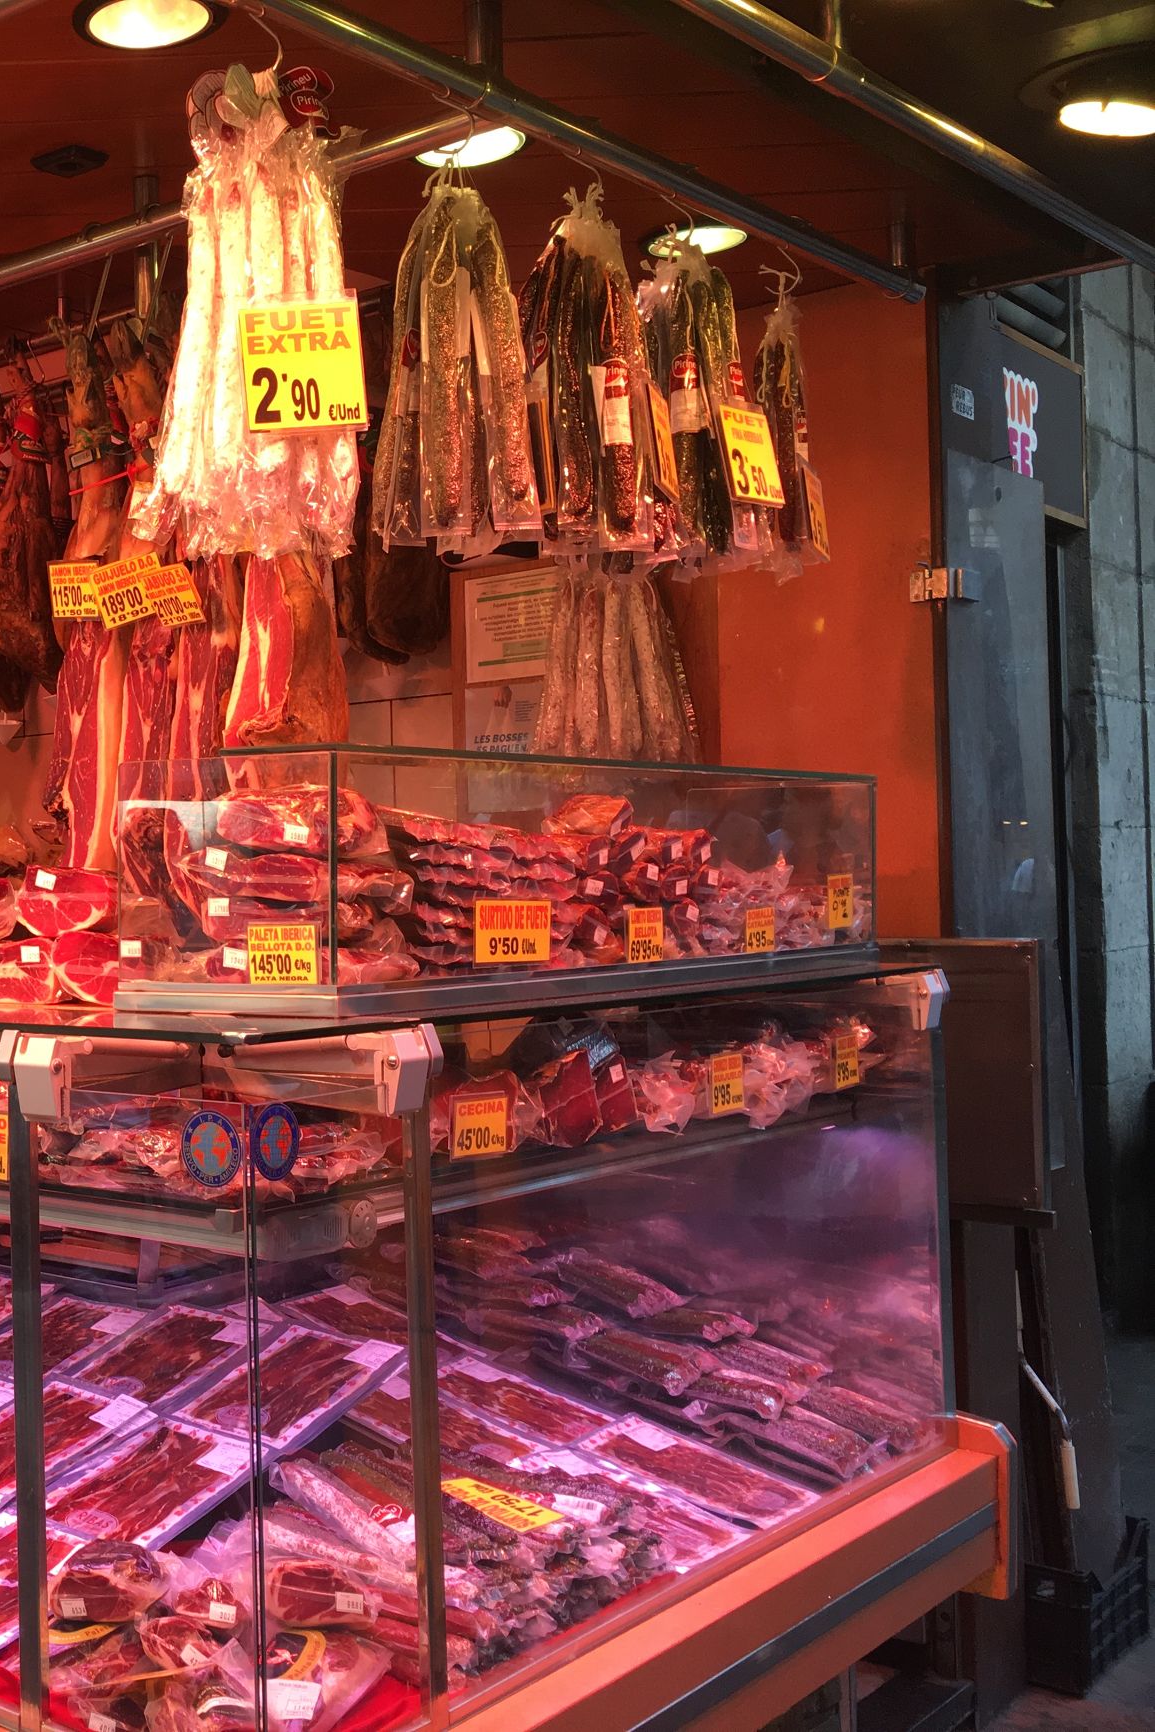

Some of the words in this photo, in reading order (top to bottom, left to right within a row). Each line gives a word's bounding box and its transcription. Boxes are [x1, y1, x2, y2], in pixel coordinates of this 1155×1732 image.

[245, 307, 350, 333] FUET
[247, 330, 351, 355] EXTRA
[252, 367, 320, 424] 2'90
[329, 403, 360, 421] €/Und
[723, 410, 764, 428] FUET
[731, 448, 768, 497] 3'50
[94, 562, 137, 584] GUIJUELO
[139, 556, 156, 569] D.O.
[145, 573, 176, 590] JABUGO
[53, 585, 82, 607] 115'00
[102, 587, 143, 616] 189'00
[110, 606, 148, 624] 18'90
[154, 596, 184, 618] 210'00
[163, 614, 187, 625] 21'00
[474, 735, 491, 743] LES
[493, 732, 529, 742] BOSSES
[479, 905, 512, 930] SURTIDO
[515, 906, 525, 930] DE
[526, 905, 548, 930] FUETS
[249, 928, 278, 941] PALETA
[281, 928, 313, 941] IBERICA
[748, 931, 766, 948] 4'95
[251, 942, 292, 951] BELLOTA
[296, 943, 314, 951] D.O.
[489, 937, 518, 955] 9'50
[630, 940, 652, 961] 69'95
[251, 954, 291, 974] 145'00
[837, 1061, 849, 1082] 9'95
[714, 1084, 730, 1107] 9'95
[459, 1101, 504, 1116] CECINA
[457, 1127, 490, 1151] 45'00
[490, 1494, 544, 1518] 17'50
[79, 1512, 108, 1528] RIBAS
